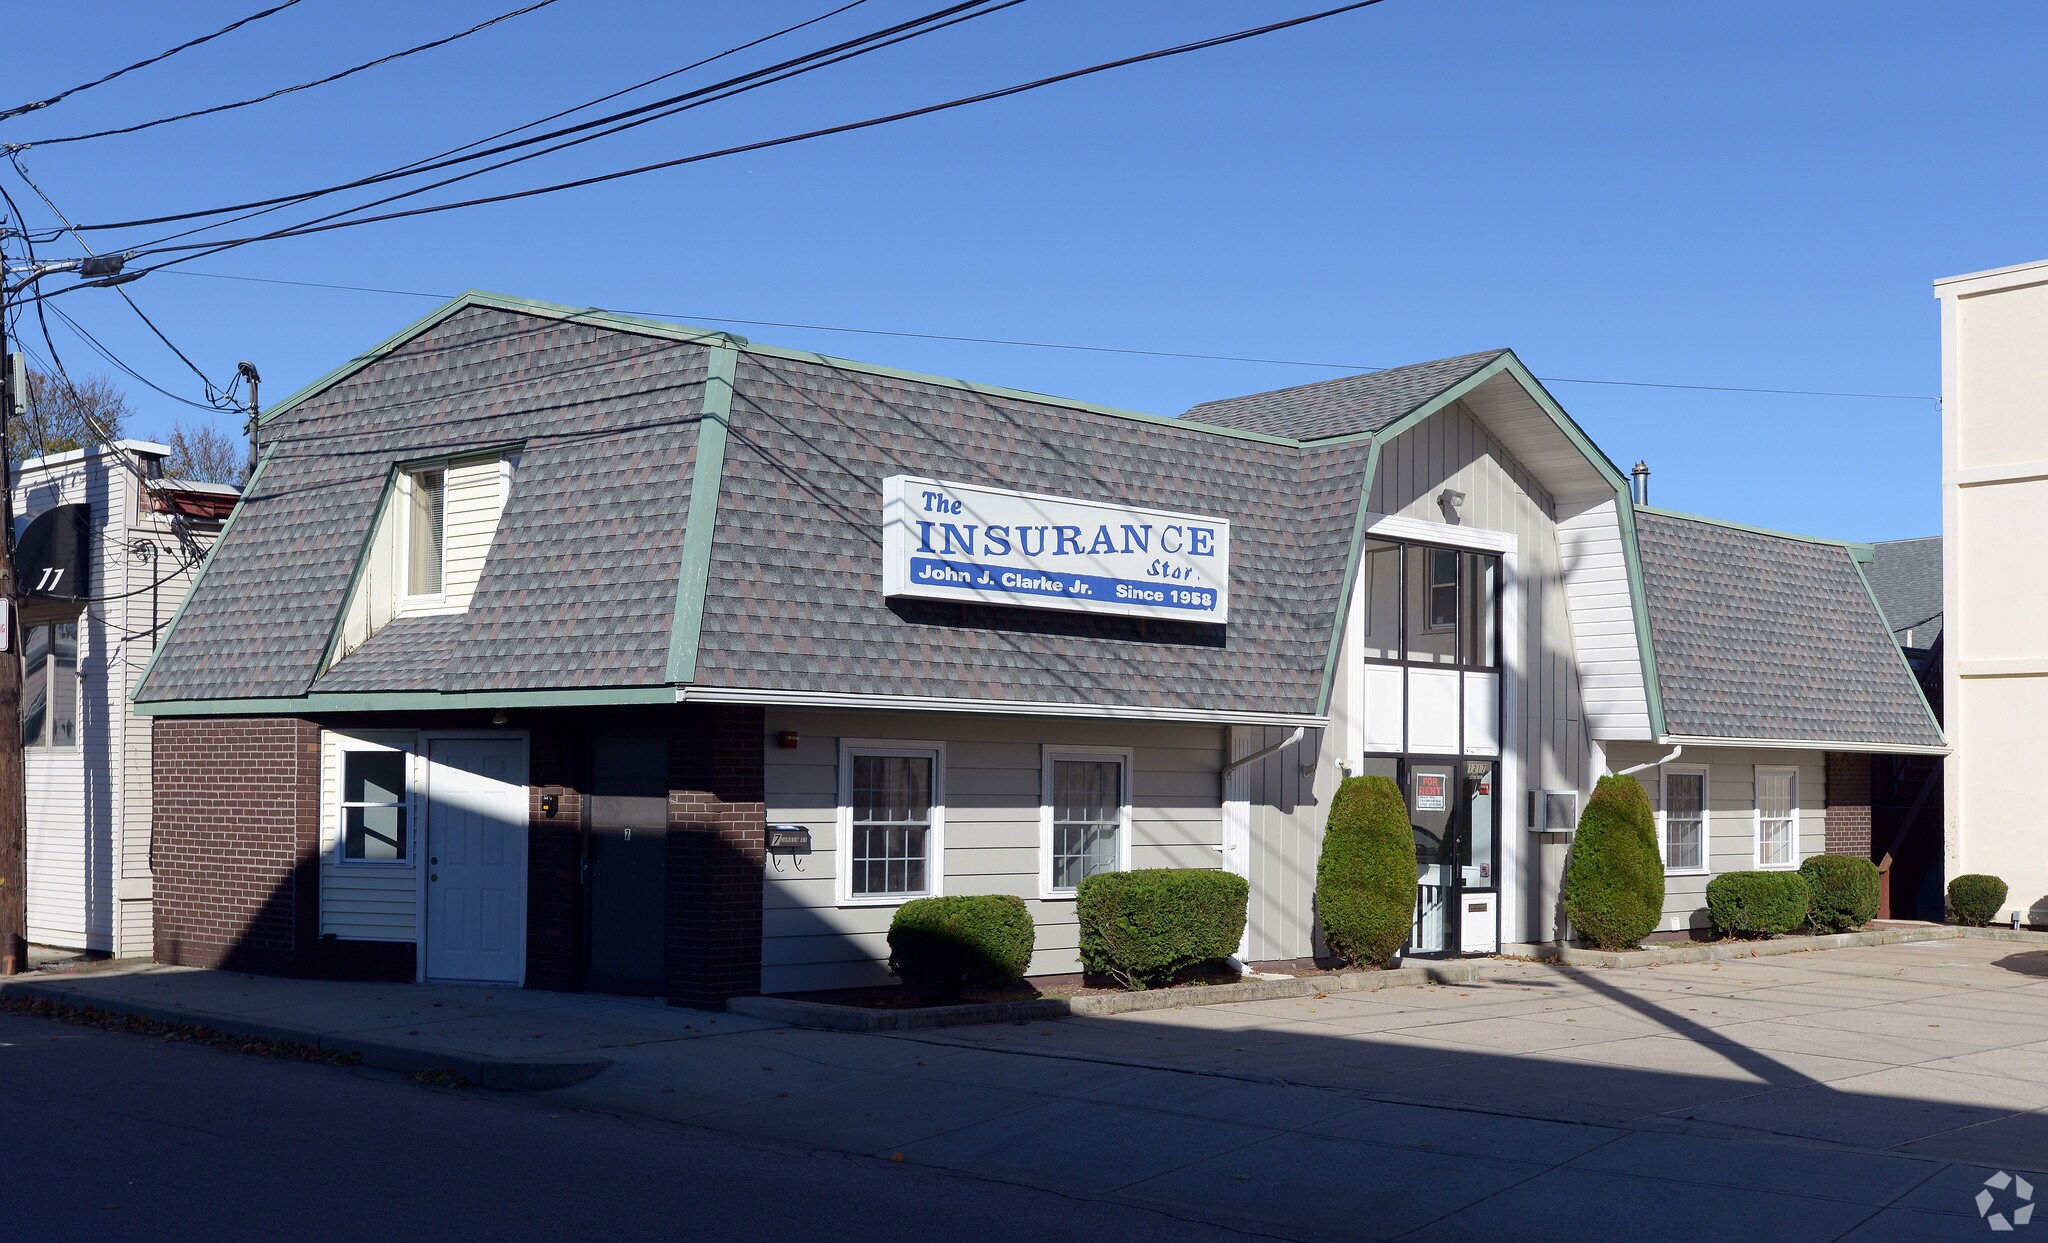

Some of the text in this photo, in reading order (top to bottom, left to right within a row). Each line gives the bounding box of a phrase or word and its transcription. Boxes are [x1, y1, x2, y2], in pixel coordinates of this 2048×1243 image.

[922, 491, 962, 515] The
[915, 520, 1215, 558] INSURANCE
[36, 567, 65, 591] 11
[918, 564, 1212, 607] John J. Clarke Jr. Since 1958
[1419, 786, 1442, 796] RENT
[1423, 777, 1438, 786] FOR
[772, 833, 782, 846] 7
